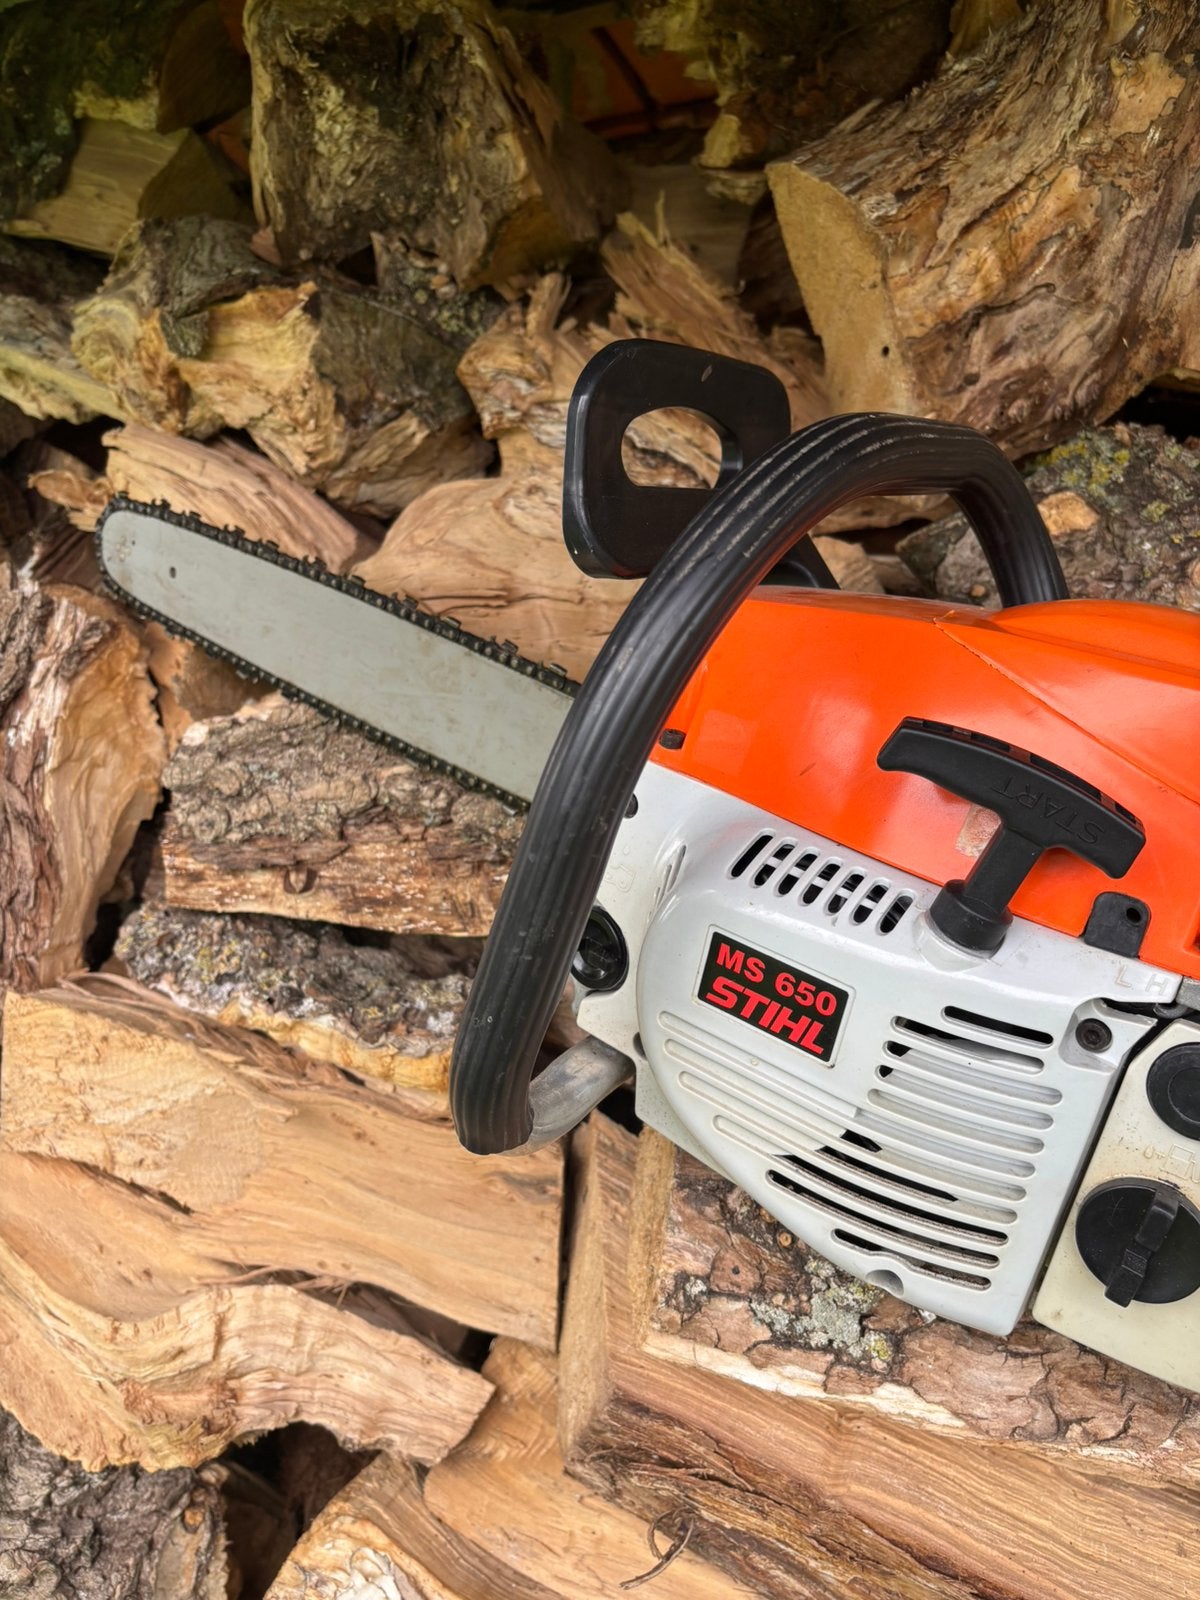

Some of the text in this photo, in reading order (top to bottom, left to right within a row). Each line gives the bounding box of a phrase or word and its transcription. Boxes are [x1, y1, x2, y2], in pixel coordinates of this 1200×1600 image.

[990, 776, 1105, 844] START
[705, 976, 824, 1055] STIHL
[716, 943, 837, 1016] MS 650
